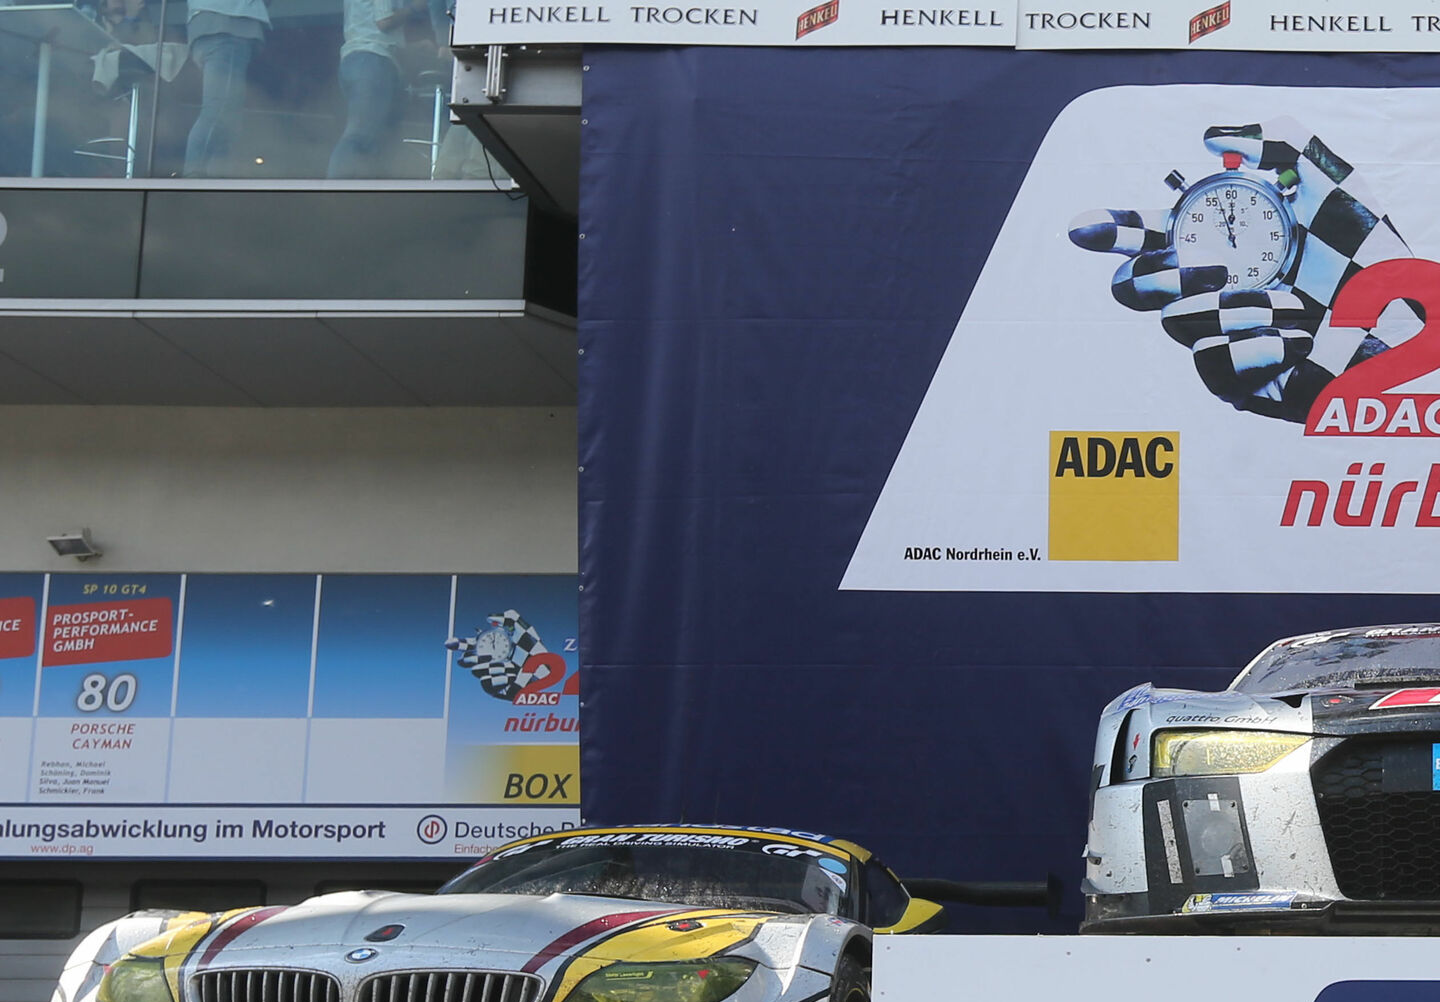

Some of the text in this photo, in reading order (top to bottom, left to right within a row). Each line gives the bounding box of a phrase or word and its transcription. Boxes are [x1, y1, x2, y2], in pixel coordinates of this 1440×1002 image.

[488, 6, 758, 25] HENKELL TROCKEN
[880, 9, 1152, 30] HENKELL TROCKEN
[1270, 14, 1392, 33] HENKELL
[1225, 190, 1238, 199] 60
[1205, 197, 1218, 207] 55
[1250, 197, 1257, 206] 5
[1192, 213, 1204, 223] 50
[1263, 211, 1273, 220] 10
[1185, 233, 1197, 243] 45
[1270, 232, 1280, 241] 15
[1262, 252, 1274, 262] 20
[1247, 268, 1260, 277] 25
[1055, 437, 1175, 478] ADAC
[904, 547, 1041, 561] ADAC Nordrhein e.V.
[83, 584, 147, 595] SP 10 GT4
[53, 608, 134, 626] PROSPORT-
[53, 619, 158, 639] PERFORMANCE
[53, 638, 95, 653] GMBH
[77, 673, 137, 712] 80
[515, 693, 559, 705] ADAC
[1166, 713, 1278, 725] quattro GmbH
[70, 723, 136, 735] PORSCHE
[72, 738, 133, 750] CAYMAN
[504, 773, 572, 799] BOX
[215, 819, 244, 839] im
[252, 819, 386, 842] Motorsport
[560, 833, 749, 846] GRAN TURISMO
[30, 844, 94, 855] www.dp.ag
[1214, 892, 1296, 905] MICHELIN
